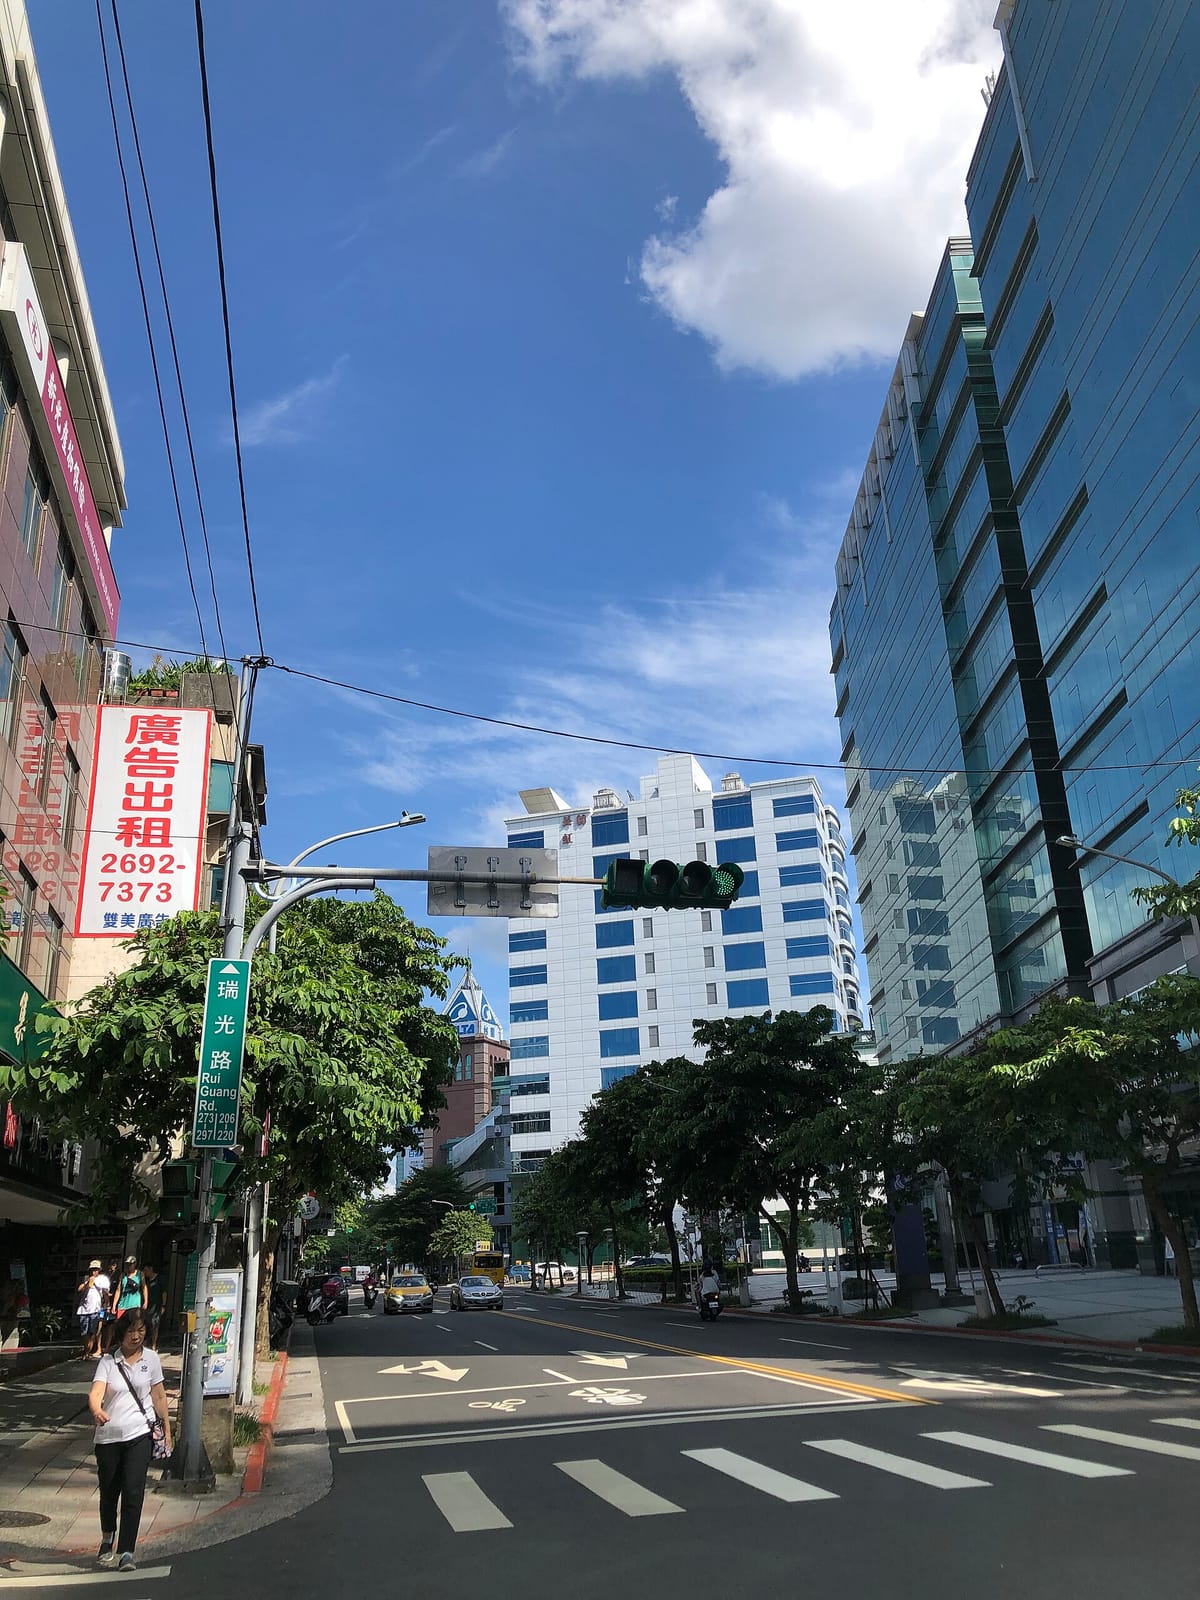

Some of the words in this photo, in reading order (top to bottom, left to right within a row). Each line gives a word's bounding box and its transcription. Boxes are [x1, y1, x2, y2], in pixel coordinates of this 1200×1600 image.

[115, 714, 182, 848] 廣告出租
[101, 853, 185, 874] 2692-
[98, 881, 172, 902] 7373
[210, 981, 239, 1070] 瑞光路
[202, 1072, 220, 1084] Rui
[200, 1085, 237, 1101] Guang
[199, 1099, 217, 1111] Rd.
[198, 1113, 214, 1123] 273
[219, 1113, 235, 1124] 206
[196, 1130, 212, 1140] 297
[217, 1130, 233, 1141] 220
